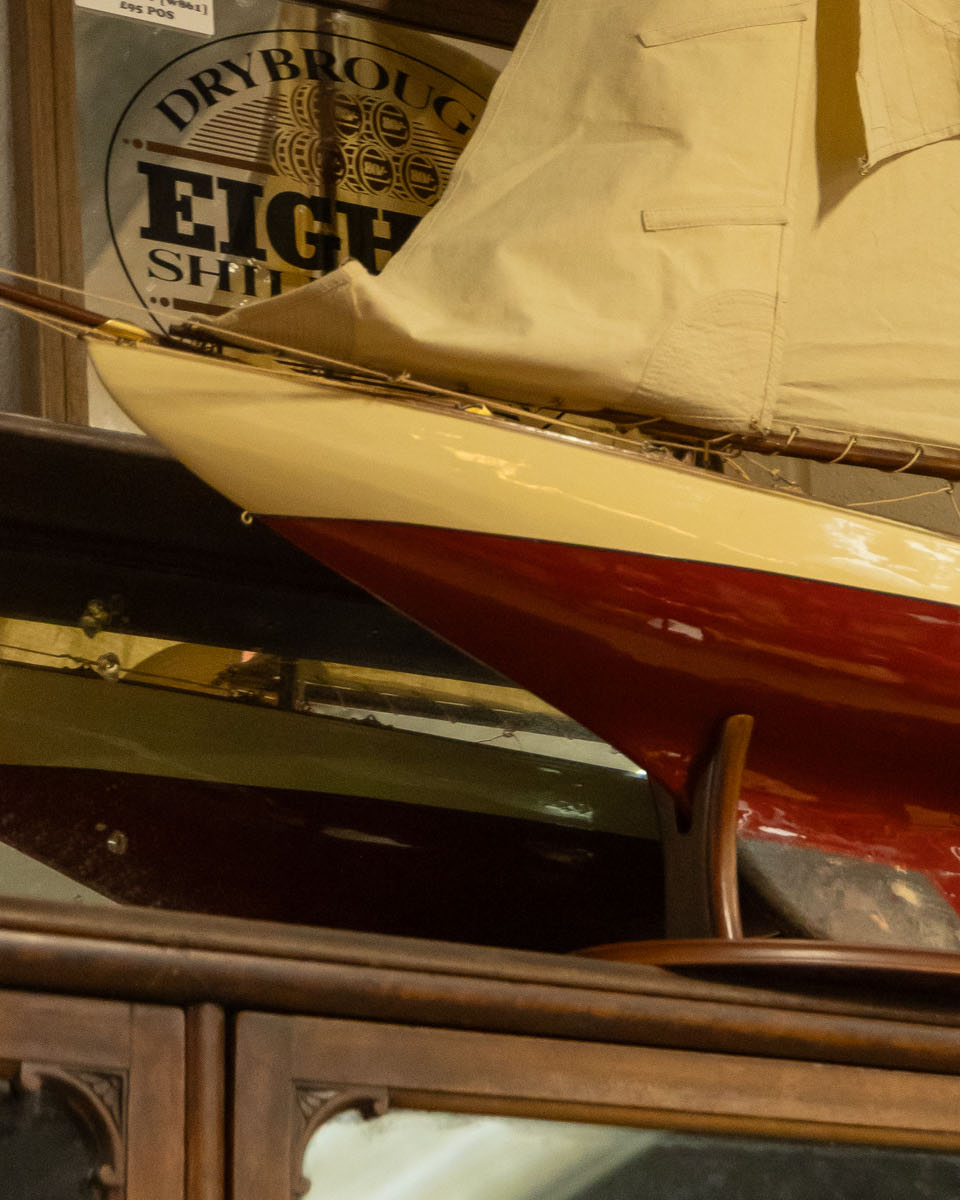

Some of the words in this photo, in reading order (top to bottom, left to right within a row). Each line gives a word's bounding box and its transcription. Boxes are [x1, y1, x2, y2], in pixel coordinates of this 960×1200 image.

[120, 1, 143, 14] £95
[147, 5, 175, 19] POS
[155, 47, 476, 135] DRYBROUG
[138, 160, 423, 277] EIGH
